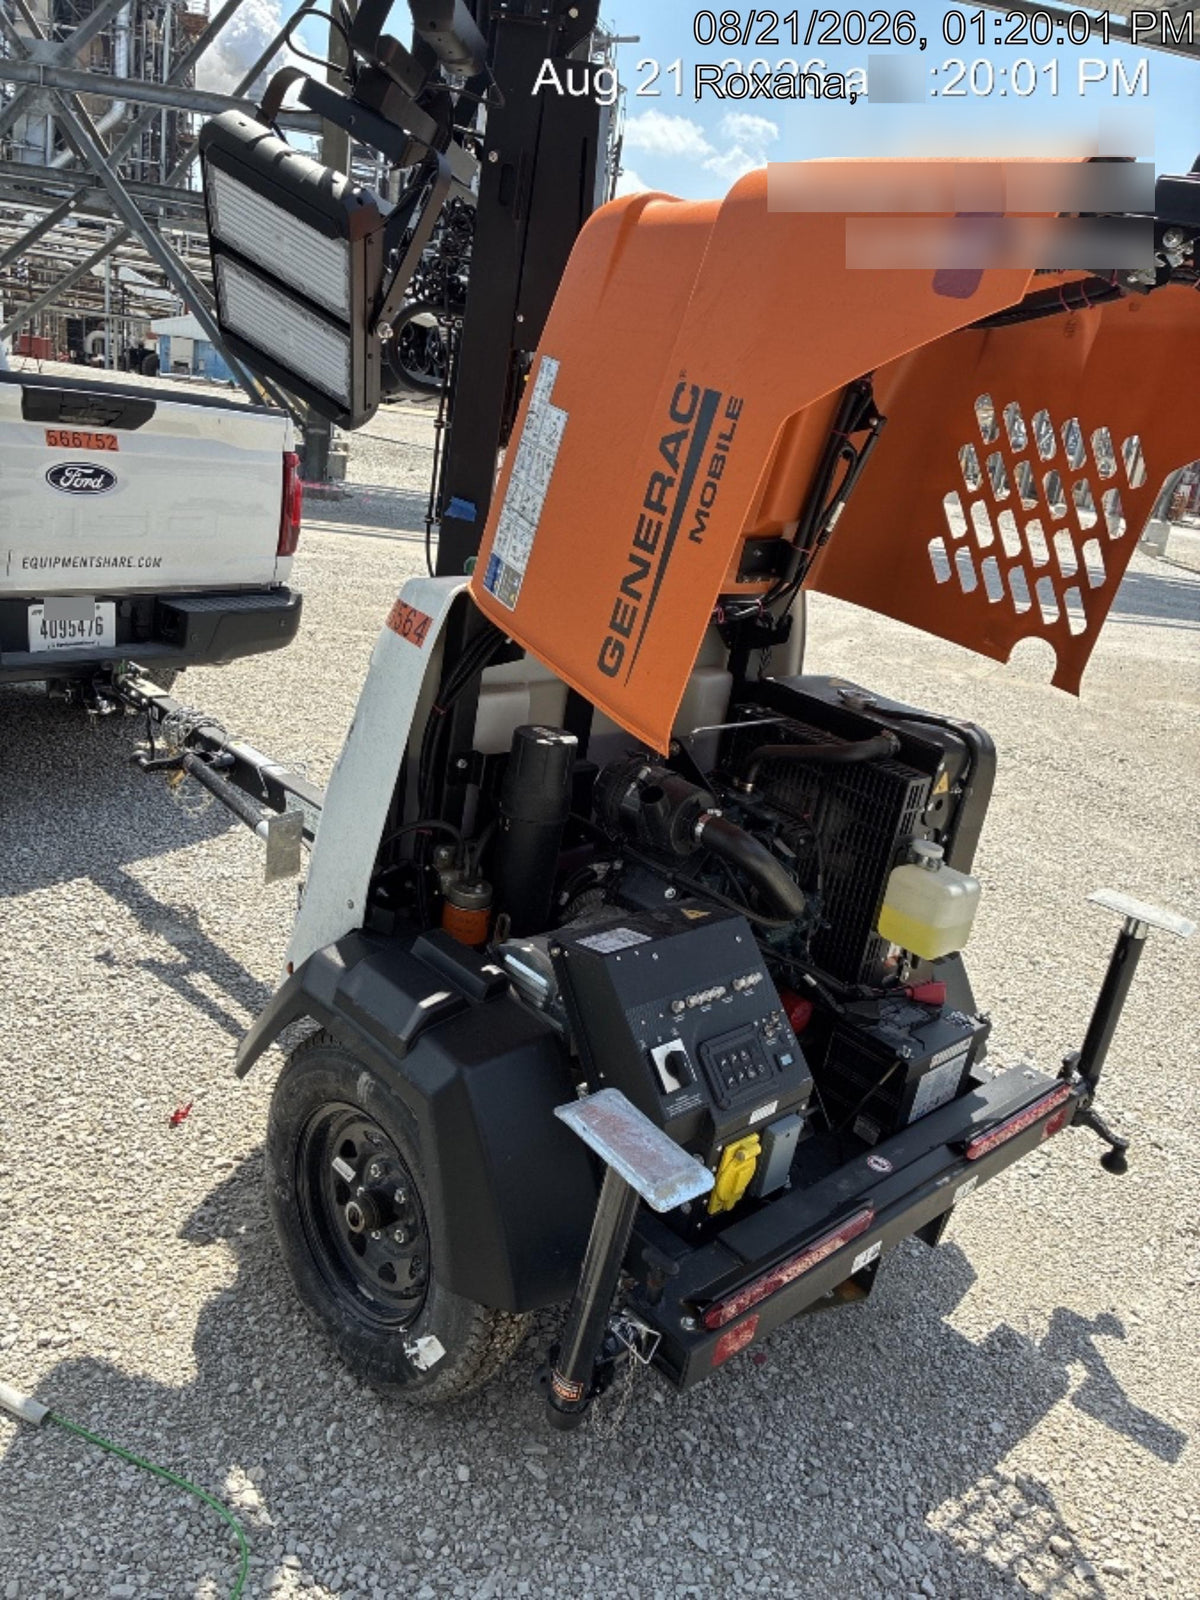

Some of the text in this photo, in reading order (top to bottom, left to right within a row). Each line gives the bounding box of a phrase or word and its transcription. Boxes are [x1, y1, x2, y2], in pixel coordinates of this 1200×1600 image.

[48, 430, 118, 450] 566752
[60, 467, 104, 489] Ford
[688, 395, 744, 544] MOBILE
[597, 380, 700, 679] GENERAC
[22, 556, 162, 570] EQUIPMENTSHARE.COM
